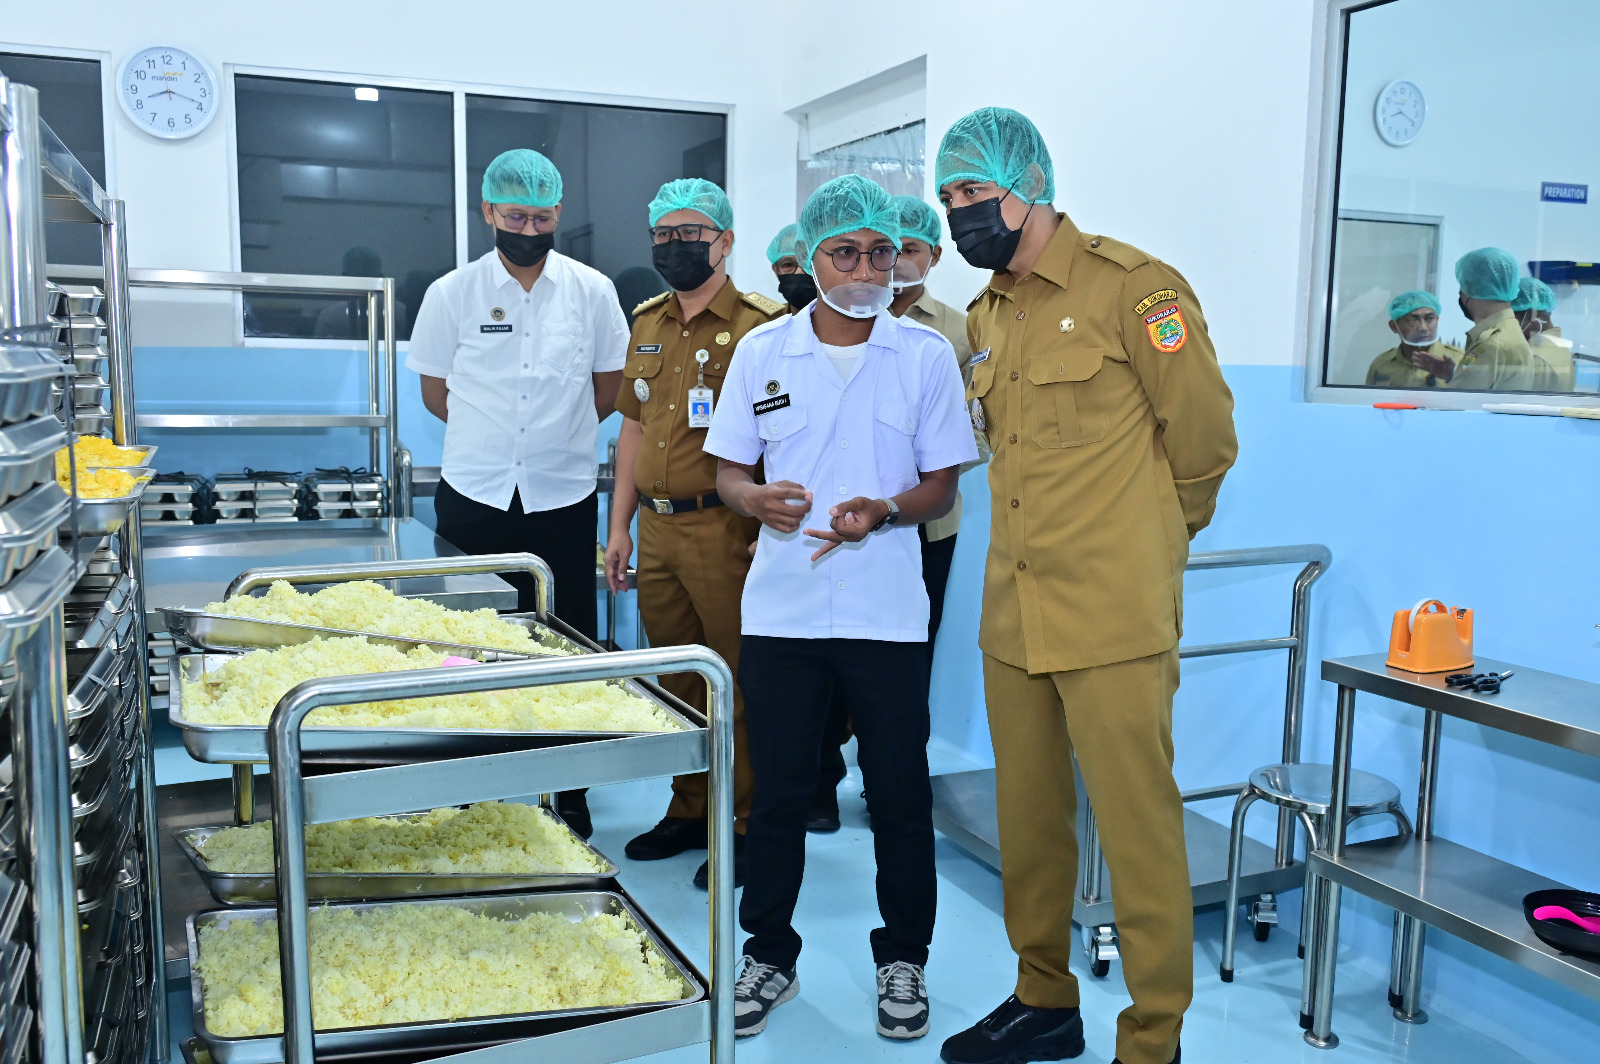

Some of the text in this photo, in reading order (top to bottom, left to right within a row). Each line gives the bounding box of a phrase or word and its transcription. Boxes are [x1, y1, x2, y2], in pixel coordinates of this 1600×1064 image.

[146, 59, 156, 69] 11
[161, 55, 172, 65] 12
[181, 61, 186, 70] 1
[134, 70, 146, 80] 10
[194, 73, 201, 83] 2
[130, 84, 138, 94] 9
[200, 88, 206, 98] 3
[136, 100, 144, 110] 8
[196, 102, 204, 112] 4
[150, 112, 157, 122] 7
[184, 114, 192, 124] 5
[168, 118, 175, 128] 6
[1544, 186, 1584, 200] PREPARATION
